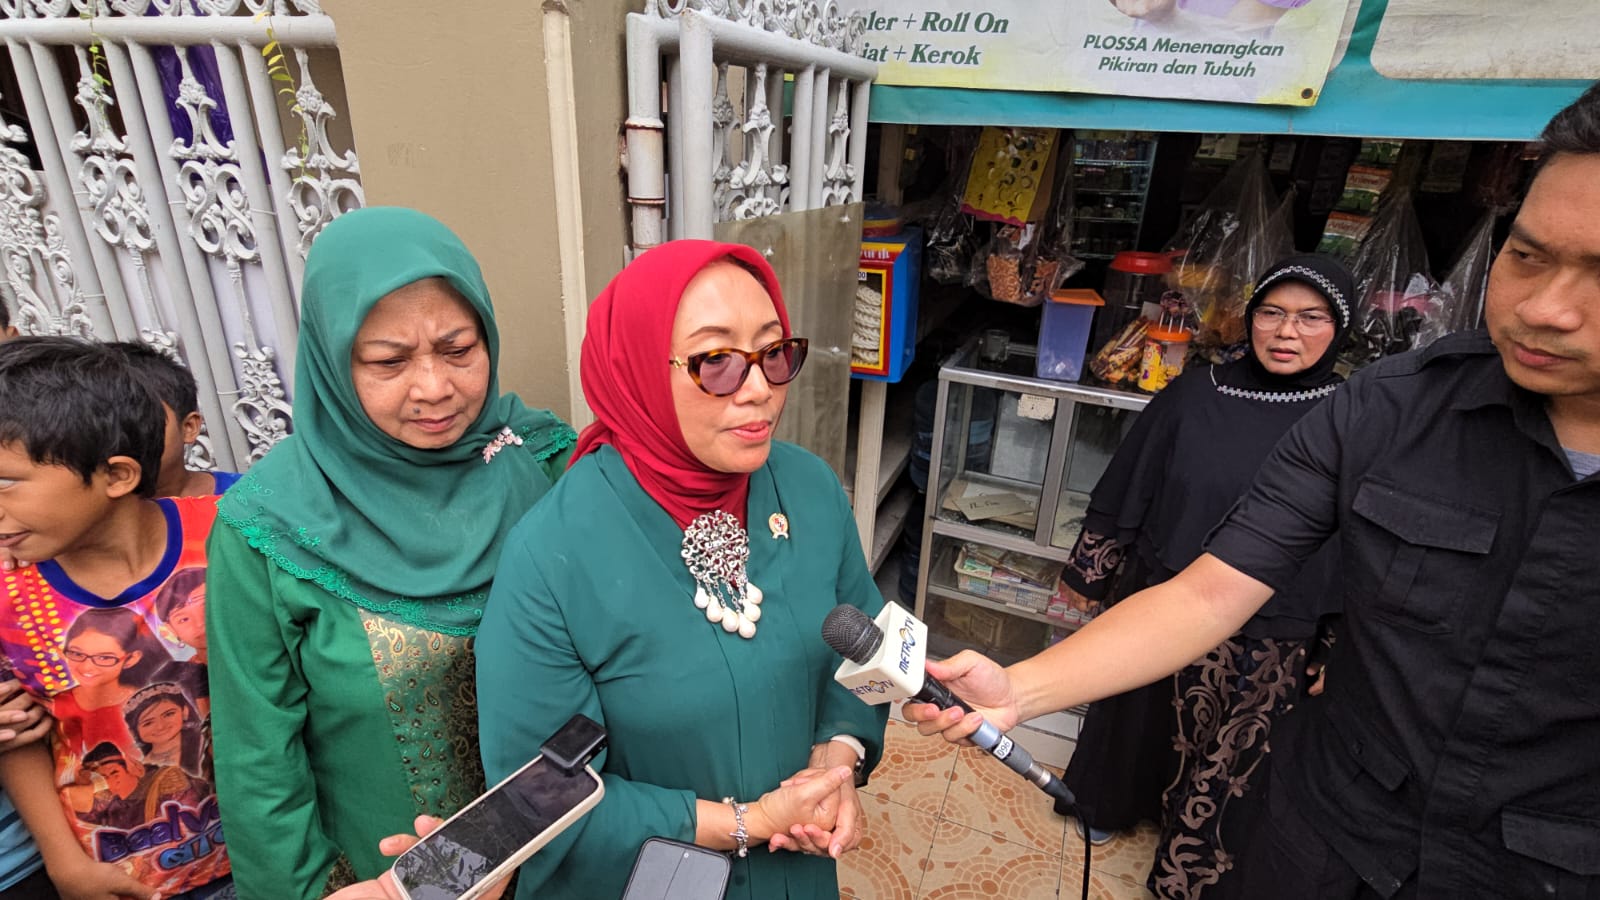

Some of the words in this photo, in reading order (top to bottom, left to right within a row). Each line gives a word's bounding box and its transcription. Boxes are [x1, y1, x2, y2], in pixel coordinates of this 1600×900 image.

[863, 10, 898, 31] ler
[903, 13, 917, 30] +
[920, 11, 971, 33] Roll
[974, 12, 1009, 33] On
[893, 45, 907, 61] +
[909, 43, 982, 65] Kerok
[1083, 34, 1148, 51] PLOSSA
[1152, 38, 1285, 59] Menenangkan
[1098, 56, 1158, 74] Pikiran
[1163, 59, 1197, 75] dan
[1203, 61, 1256, 78] Tubuh
